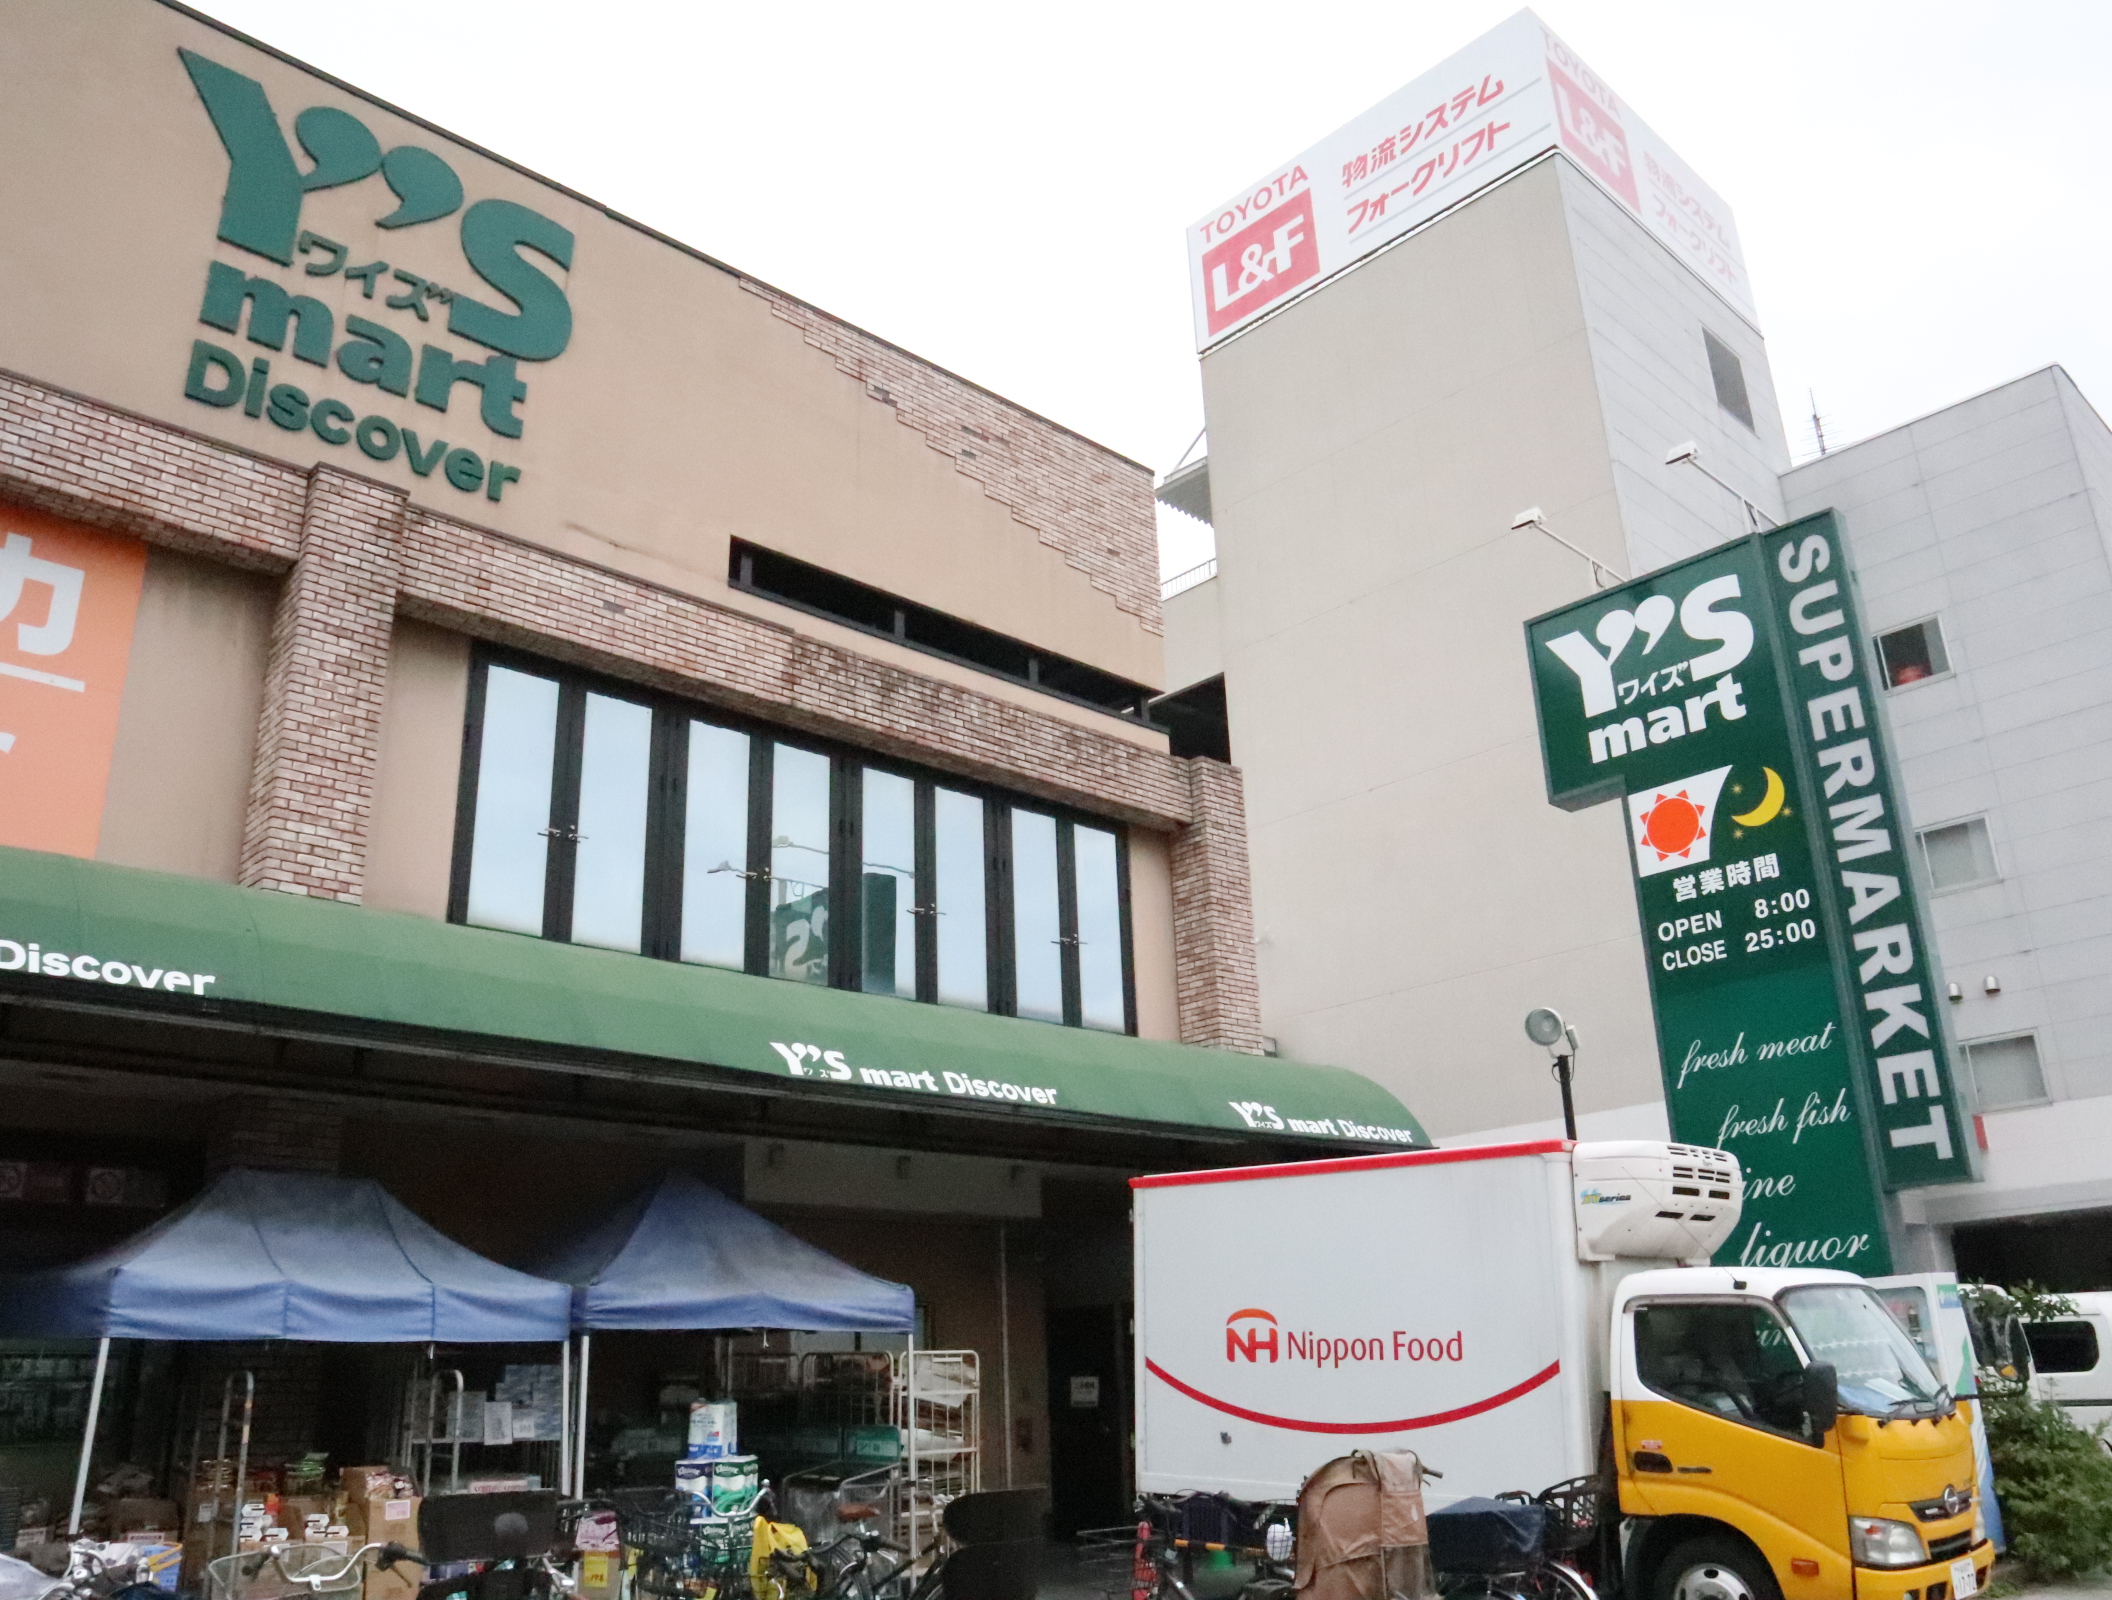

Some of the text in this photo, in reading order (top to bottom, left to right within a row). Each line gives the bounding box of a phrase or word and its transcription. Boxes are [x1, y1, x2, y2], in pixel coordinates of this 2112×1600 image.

[1341, 74, 1504, 188] 物流システム
[1200, 165, 1308, 244] TOYOTA
[1347, 121, 1510, 234] フォークリフト
[298, 230, 454, 321] ワイズ
[1211, 213, 1304, 312] L&F
[199, 260, 527, 439] mart
[184, 339, 521, 502] Discover
[1618, 661, 1689, 705] ワイズ
[1588, 673, 1747, 764] mart
[1672, 853, 1780, 903] 営業時間
[1778, 533, 1954, 1159] SUPERMARKET
[1658, 888, 1810, 942] OPEN 8:00
[1662, 919, 1816, 971] CLOSE 25:00
[859, 1067, 939, 1092] mart
[942, 1070, 1057, 1105] Discover
[1677, 1021, 1837, 1090] fresh meat
[1287, 1118, 1339, 1136] mart
[1337, 1119, 1413, 1143] Discover
[1716, 1087, 1851, 1150] fresh fish
[1742, 1168, 1796, 1199] ine
[1739, 1222, 1871, 1268] liquor
[1287, 1330, 1384, 1369] Nippon
[1393, 1330, 1463, 1362] Food
